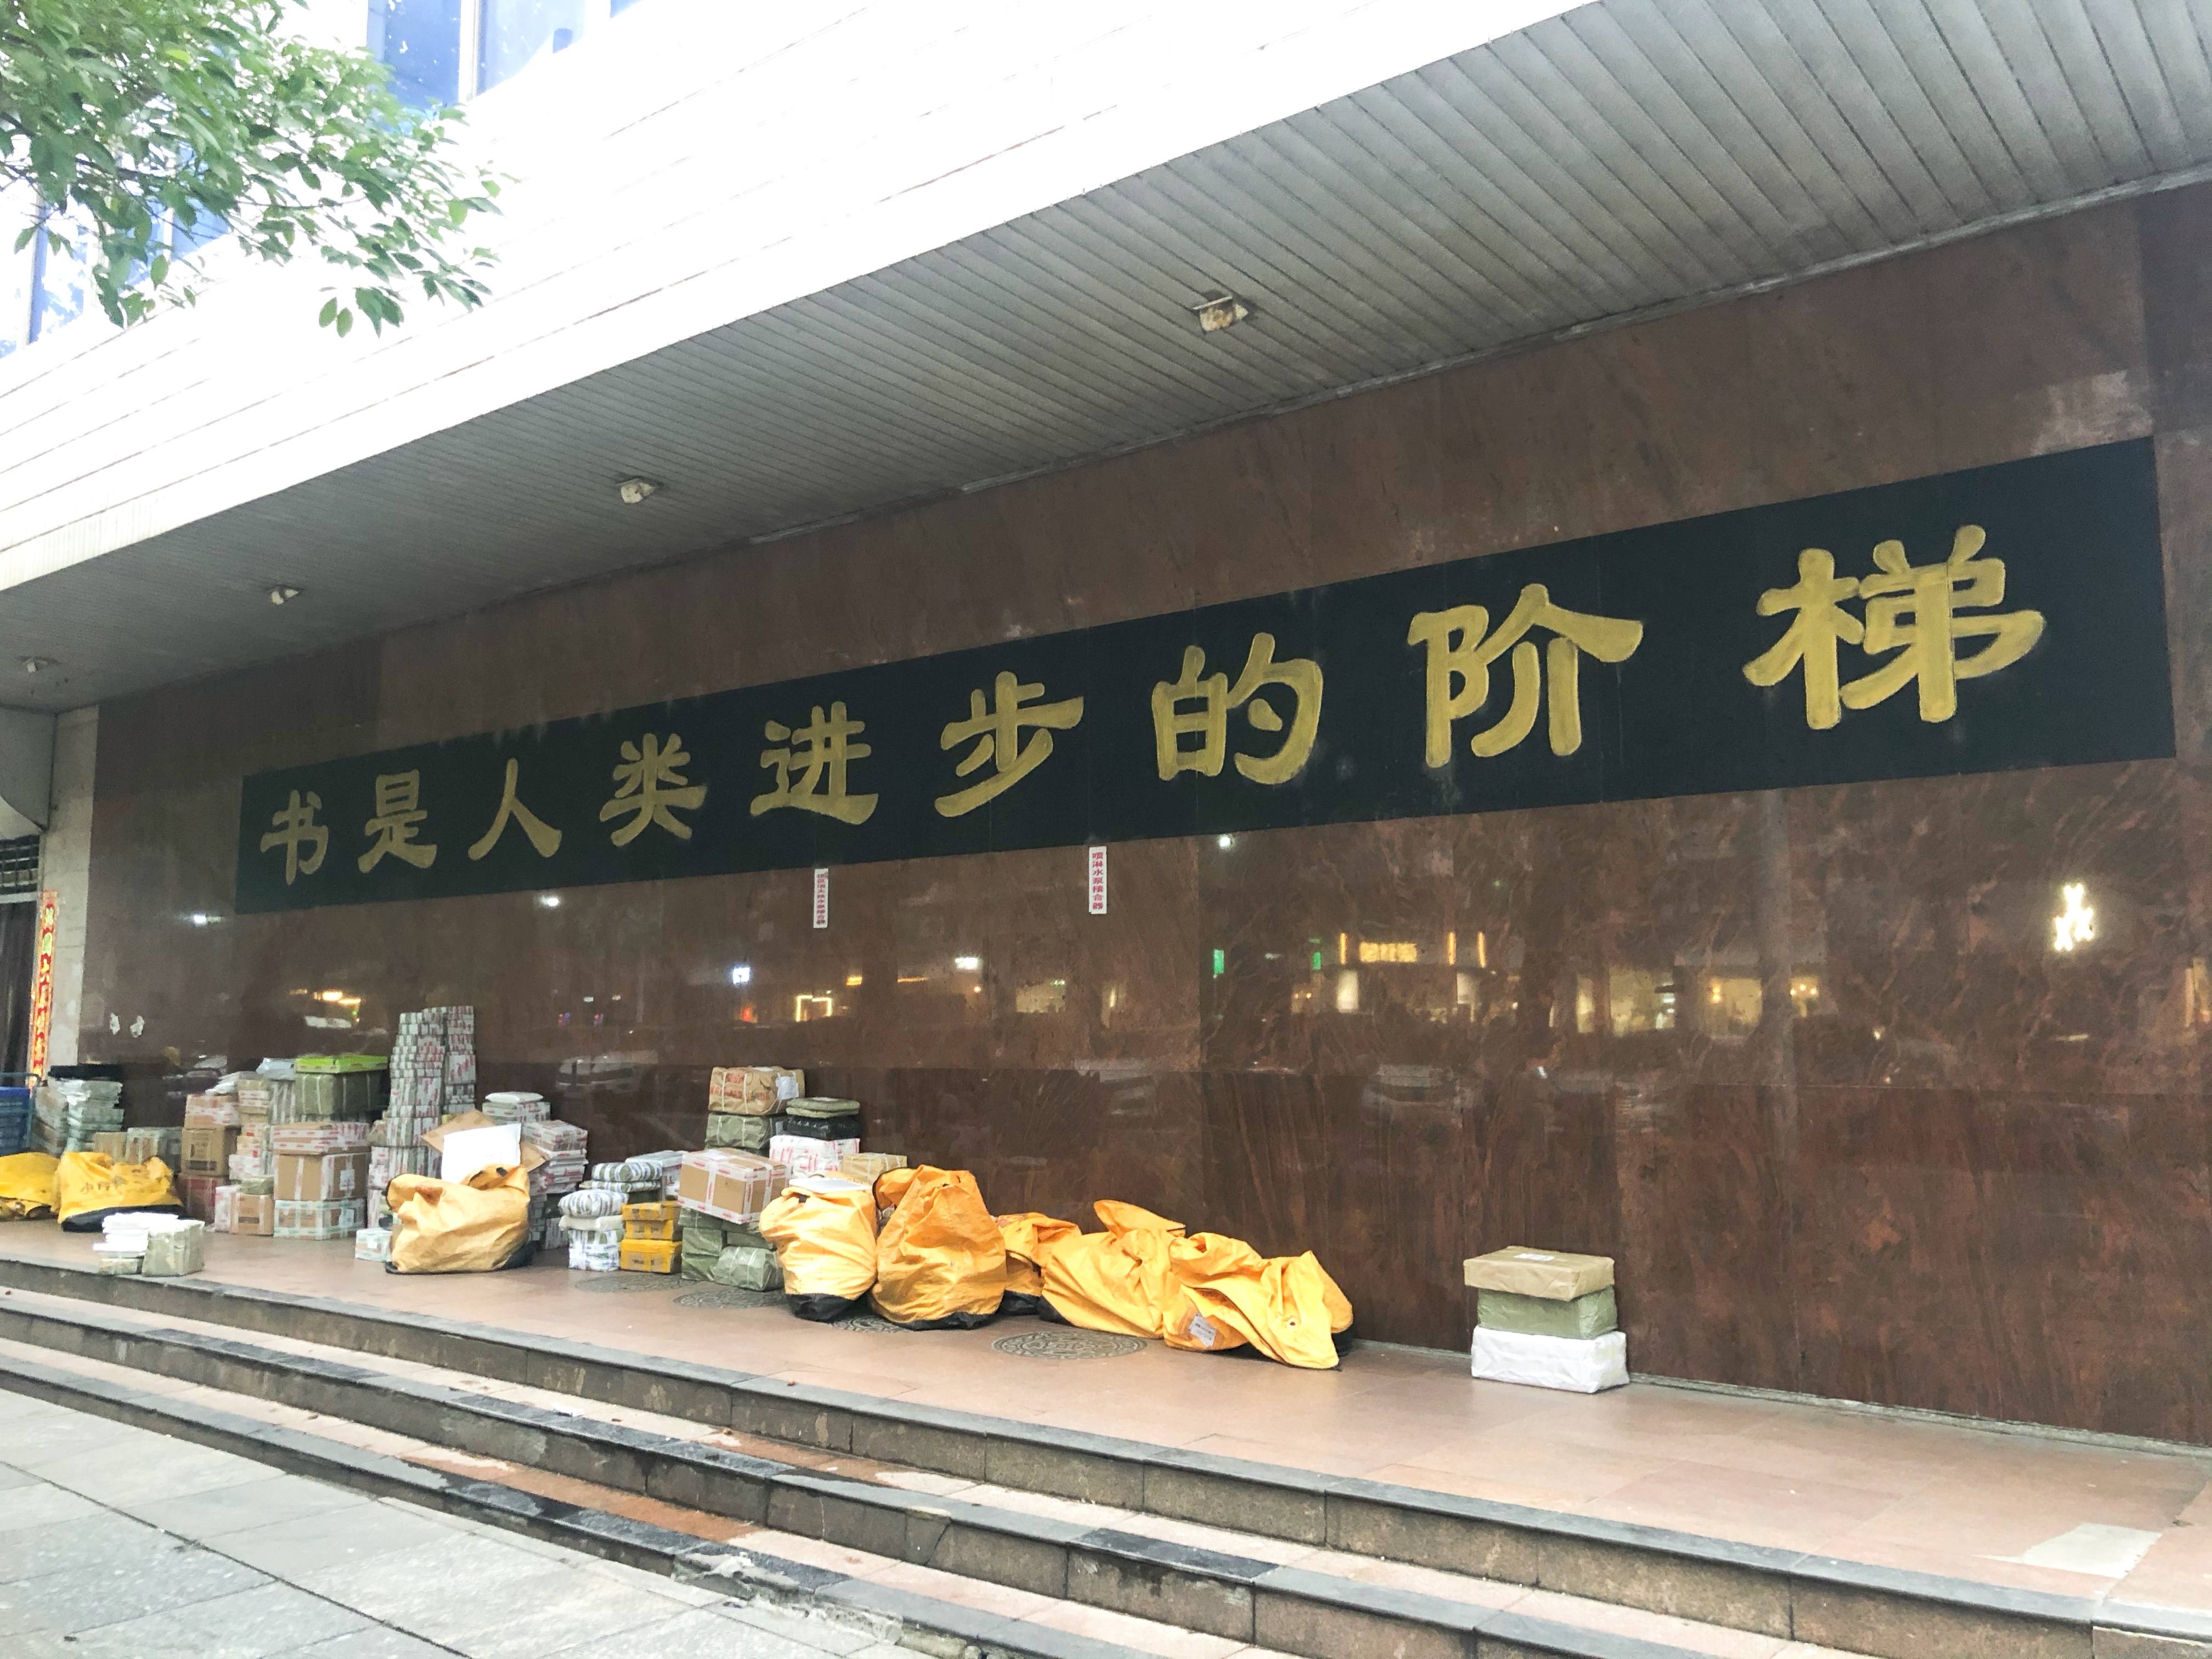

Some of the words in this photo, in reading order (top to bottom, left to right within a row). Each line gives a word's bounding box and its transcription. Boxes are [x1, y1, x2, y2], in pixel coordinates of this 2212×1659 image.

[259, 526, 2044, 885] 书是人类进步的阶梯
